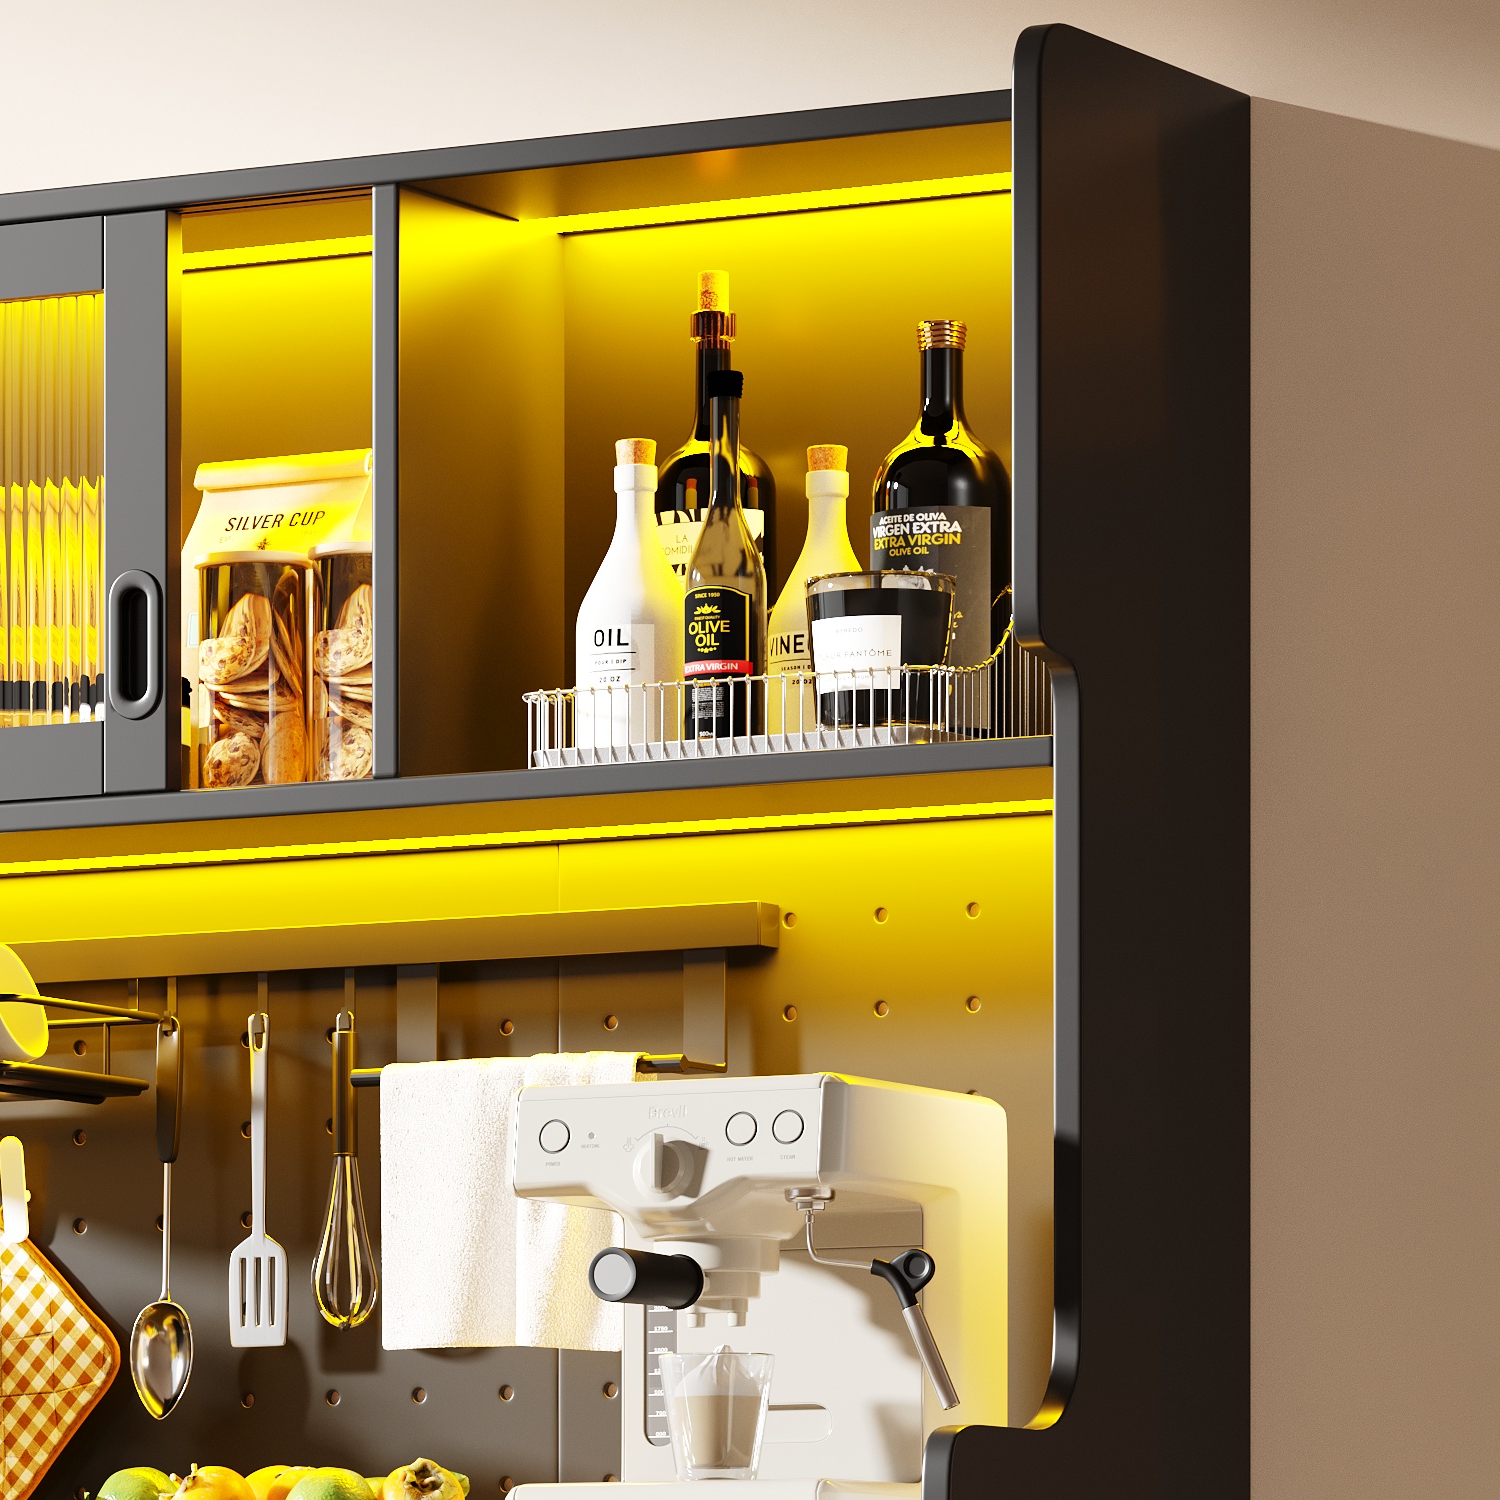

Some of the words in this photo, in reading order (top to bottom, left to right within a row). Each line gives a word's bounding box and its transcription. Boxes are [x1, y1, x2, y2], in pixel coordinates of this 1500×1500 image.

[225, 513, 285, 531] SILVER
[289, 510, 326, 527] CUP
[879, 515, 902, 526] ACEITE
[903, 514, 915, 522] DE
[915, 512, 947, 521] OLIVA
[872, 522, 910, 538] VIRGEN
[912, 520, 963, 534] EXTRA
[675, 534, 688, 544] LA
[874, 536, 906, 551] EXTRA
[908, 532, 961, 546] VIRGIN
[889, 547, 911, 557] OLIVE
[912, 546, 929, 555] OIL
[688, 620, 731, 635] OLIVE
[594, 628, 629, 647] OIL
[694, 633, 720, 647] OIL
[769, 633, 810, 657] VINE
[684, 663, 706, 674] EXTRA
[706, 662, 739, 671] VIRGIN
